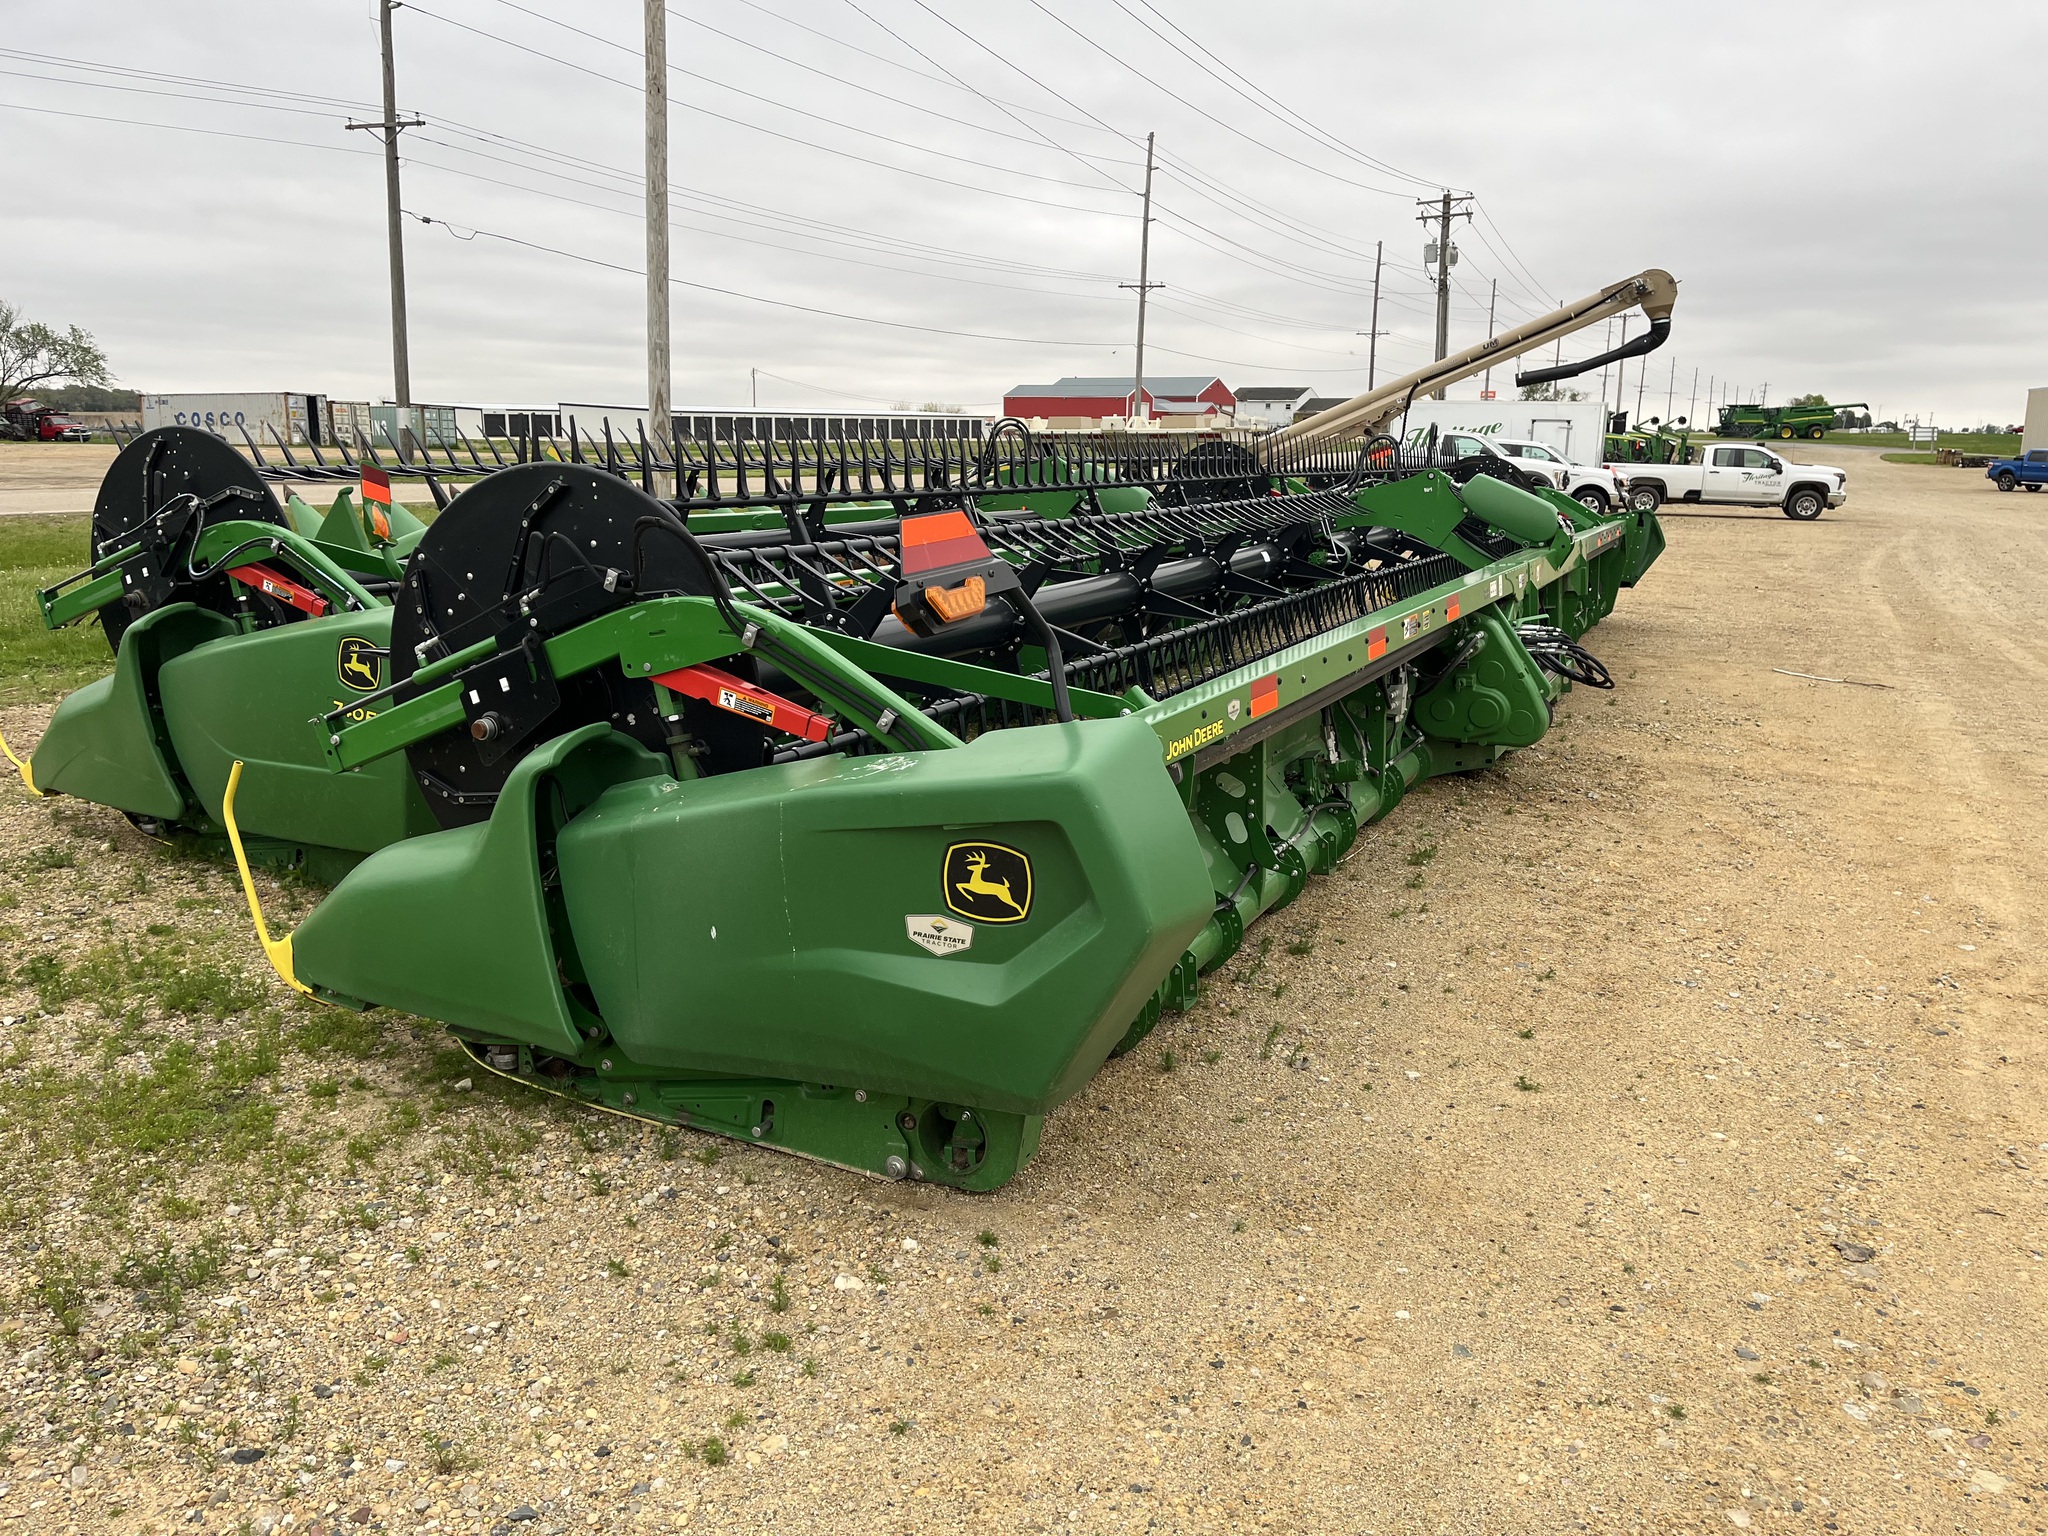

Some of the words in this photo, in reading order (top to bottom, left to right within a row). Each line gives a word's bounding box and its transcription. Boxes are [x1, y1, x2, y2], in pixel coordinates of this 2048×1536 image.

[176, 411, 245, 427] COSCO
[1166, 734, 1193, 761] JOHN
[1193, 719, 1224, 746] DEERE
[912, 930, 942, 941] PRAIRIE
[943, 936, 967, 945] STATE
[921, 938, 958, 949] TRACTOR
